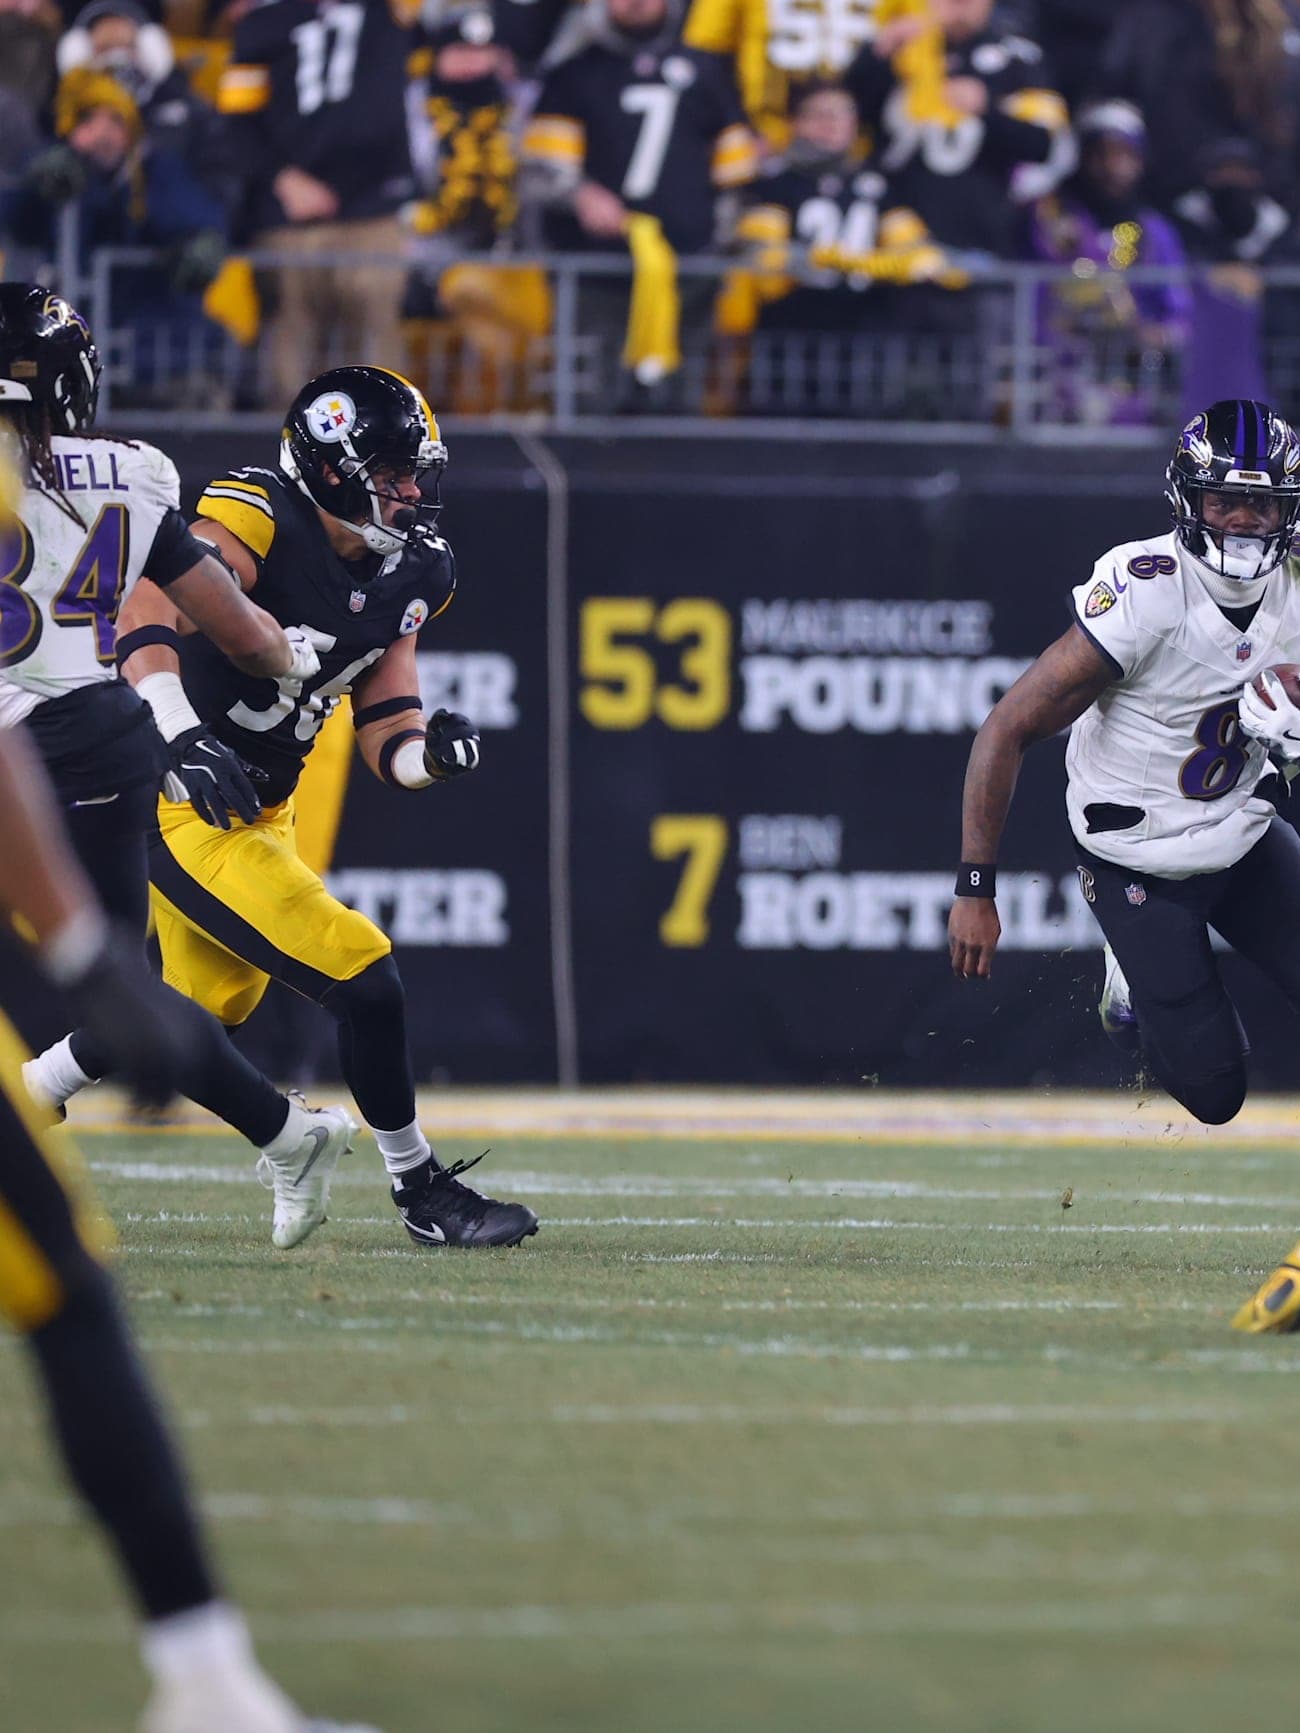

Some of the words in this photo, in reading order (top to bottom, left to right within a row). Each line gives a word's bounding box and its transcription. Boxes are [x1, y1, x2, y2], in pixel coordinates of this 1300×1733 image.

[620, 84, 682, 199] 7
[1127, 554, 1178, 580] 8
[580, 597, 732, 732] 53
[1177, 699, 1252, 801] 8
[649, 814, 729, 949] 7
[739, 815, 843, 868] BEN
[970, 870, 981, 887] 8
